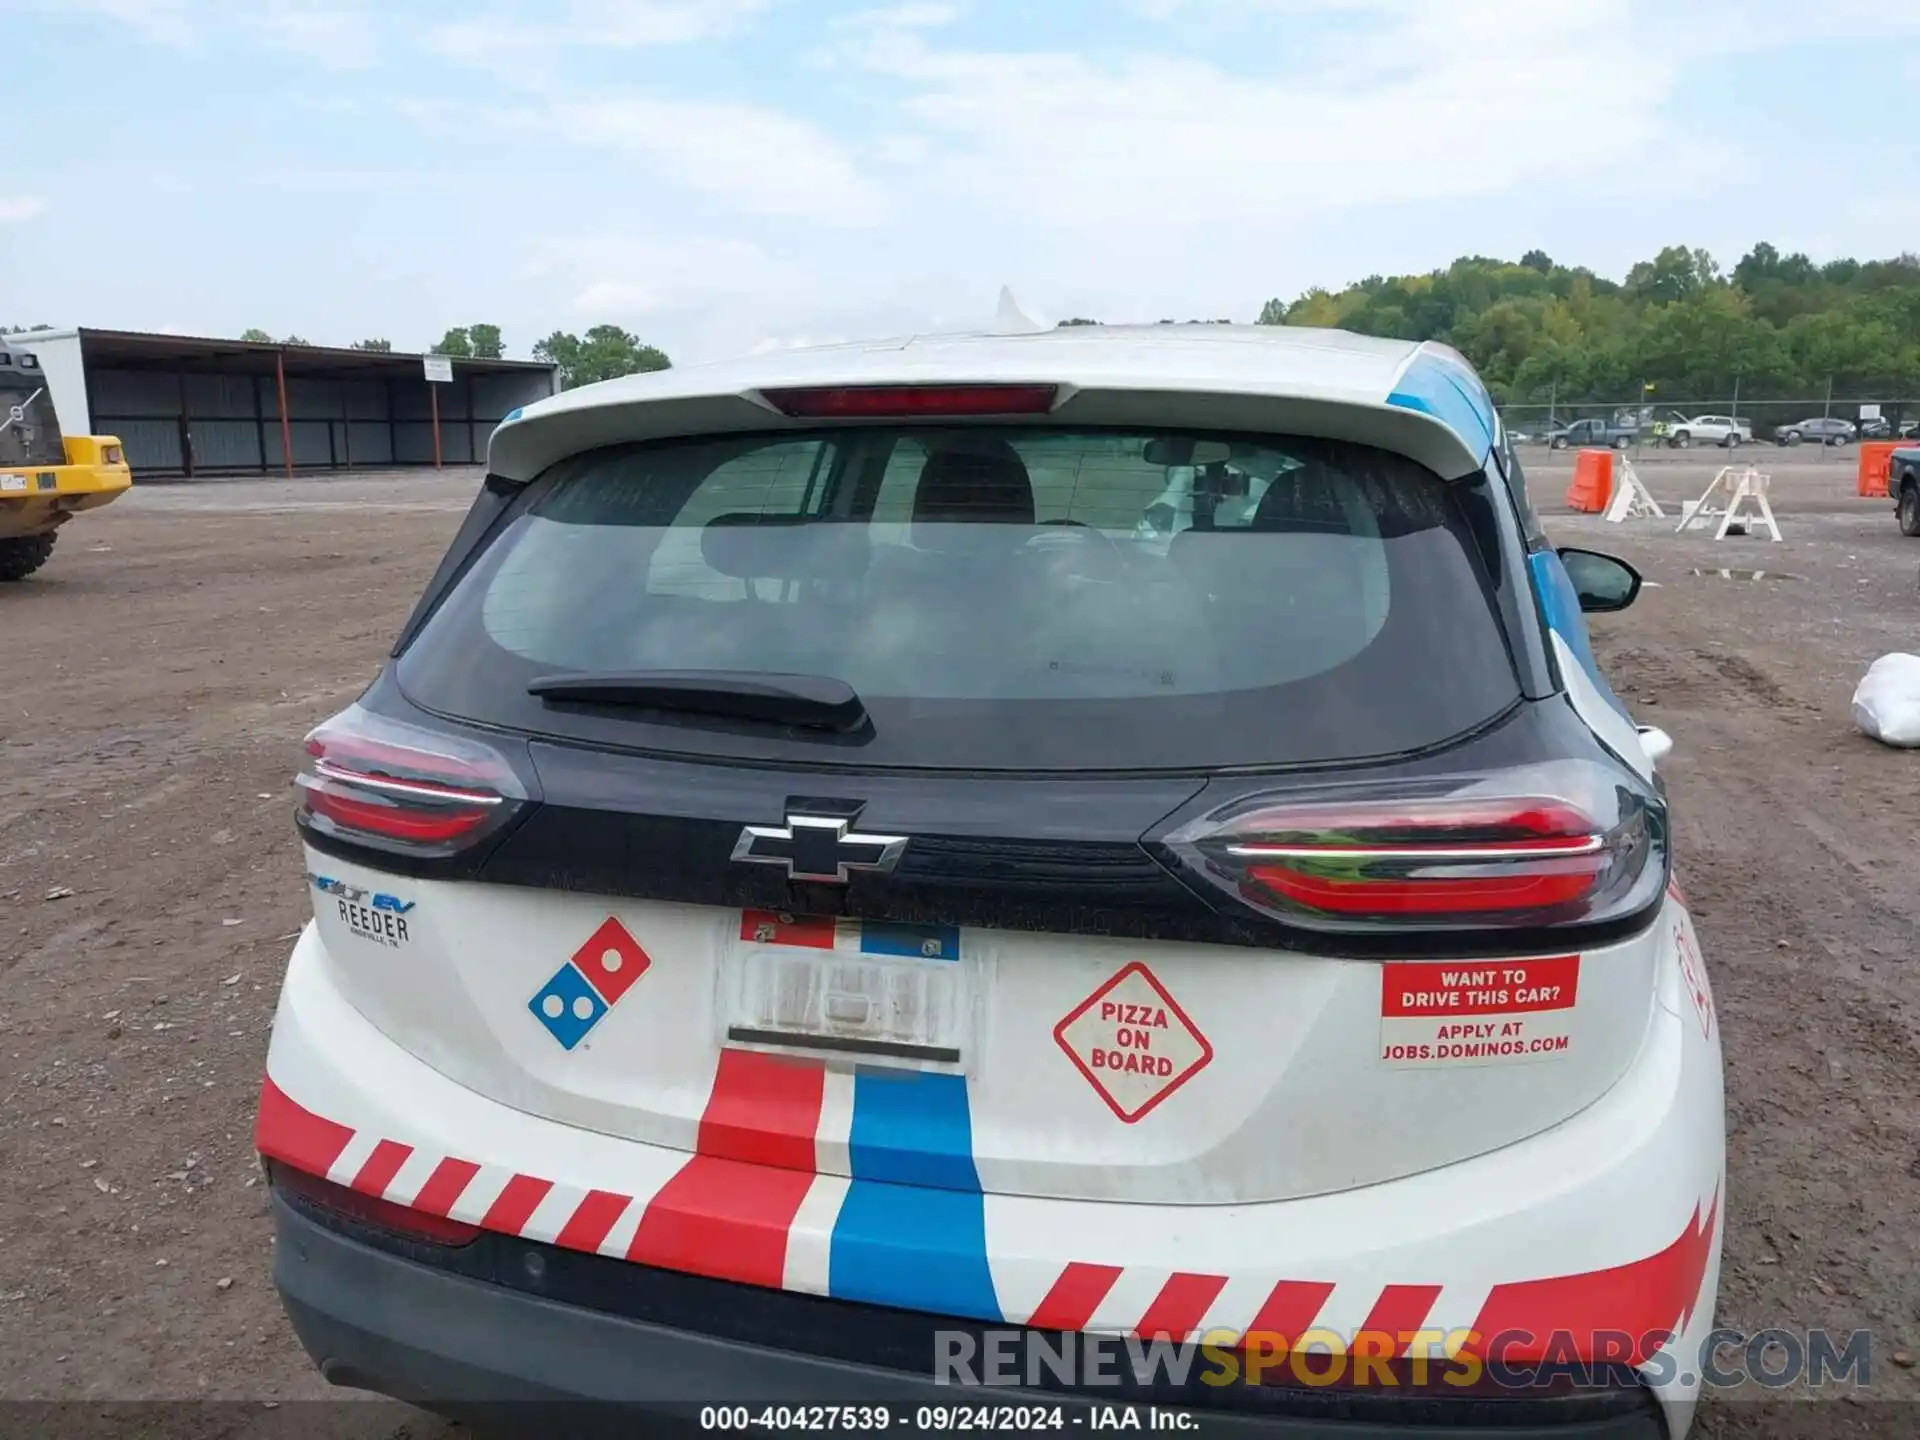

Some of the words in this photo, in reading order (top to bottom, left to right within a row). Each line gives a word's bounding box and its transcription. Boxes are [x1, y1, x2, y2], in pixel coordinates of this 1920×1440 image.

[338, 900, 409, 942] REEDER
[1441, 970, 1497, 987] WANT
[1503, 969, 1527, 984] TO
[1402, 992, 1460, 1007] DRIVE
[1466, 990, 1509, 1006] THIS
[1515, 986, 1561, 1004] CAR?
[1101, 1002, 1168, 1029] PIZZA
[1116, 1028, 1150, 1050] ON
[1437, 1023, 1496, 1040] APPLY
[1501, 1022, 1523, 1037] AT
[1382, 1036, 1569, 1060] JOBS.DOMINOS.COM
[1091, 1048, 1173, 1077] BOARD
